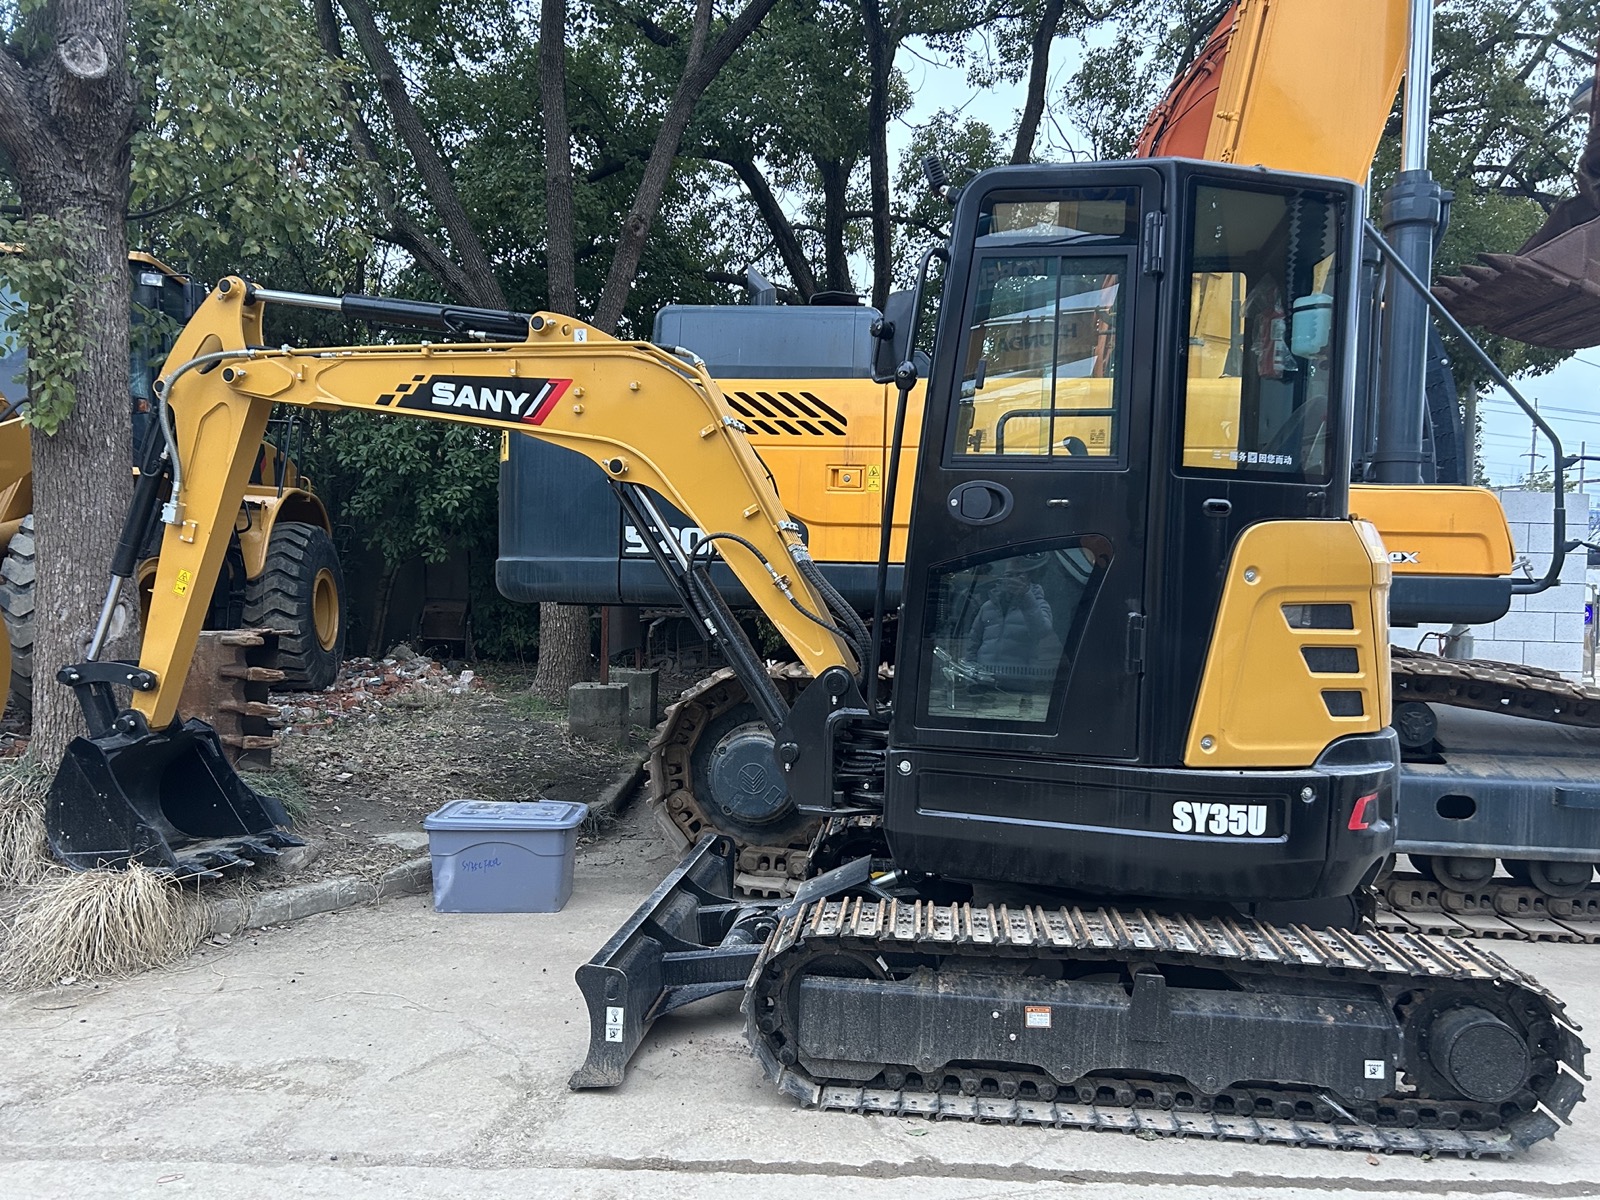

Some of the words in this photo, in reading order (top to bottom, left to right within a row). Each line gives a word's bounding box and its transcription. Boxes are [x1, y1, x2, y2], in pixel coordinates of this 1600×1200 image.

[431, 381, 530, 415] SANY
[1258, 453, 1293, 466] 因您而动
[1172, 800, 1268, 837] SY35U
